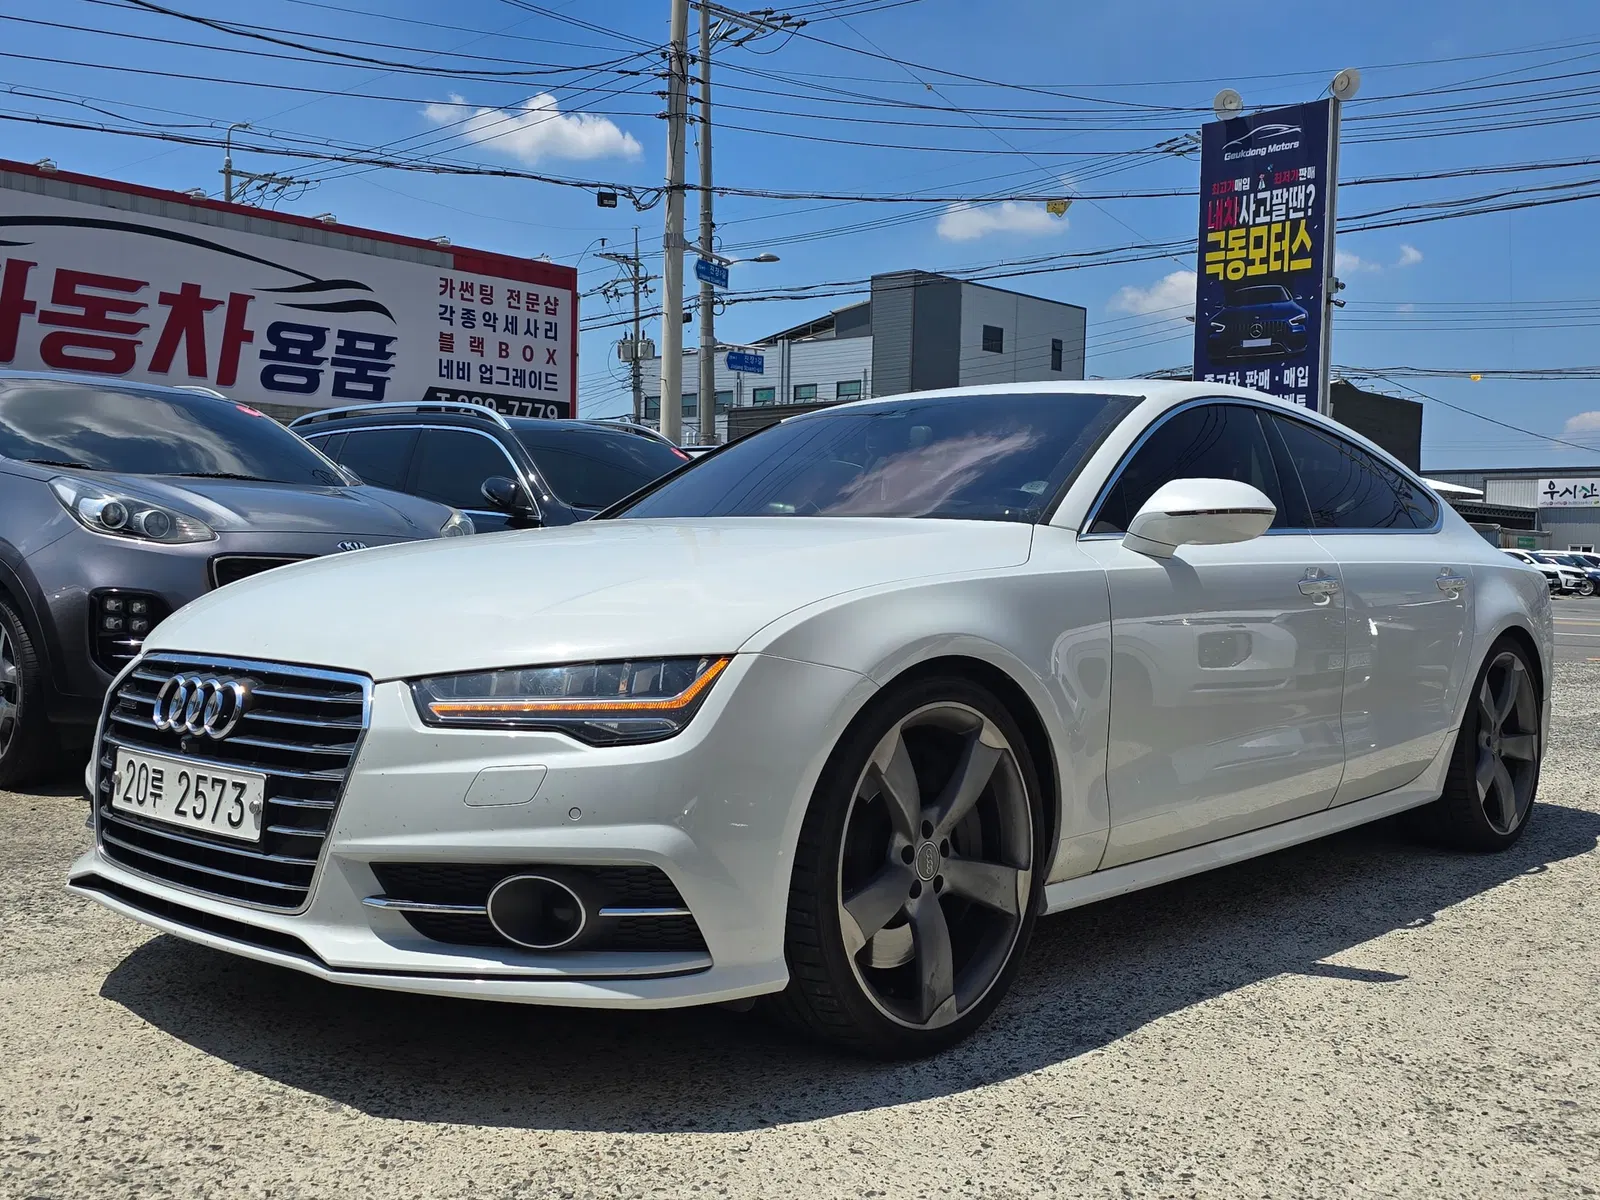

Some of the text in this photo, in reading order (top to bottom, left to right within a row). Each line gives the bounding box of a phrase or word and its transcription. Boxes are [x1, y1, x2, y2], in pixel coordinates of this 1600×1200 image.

[1224, 140, 1300, 161] Geukdong Motors
[1205, 218, 1313, 281] 극동모터스
[438, 276, 560, 316] 카썬팅 전문샵
[258, 320, 398, 402] 용품
[438, 358, 559, 392] 네비 업그레이드
[1245, 369, 1270, 390] 판매
[1283, 366, 1309, 388] 매입
[457, 395, 558, 420] 29-7779
[122, 758, 248, 830] 20루 2573
